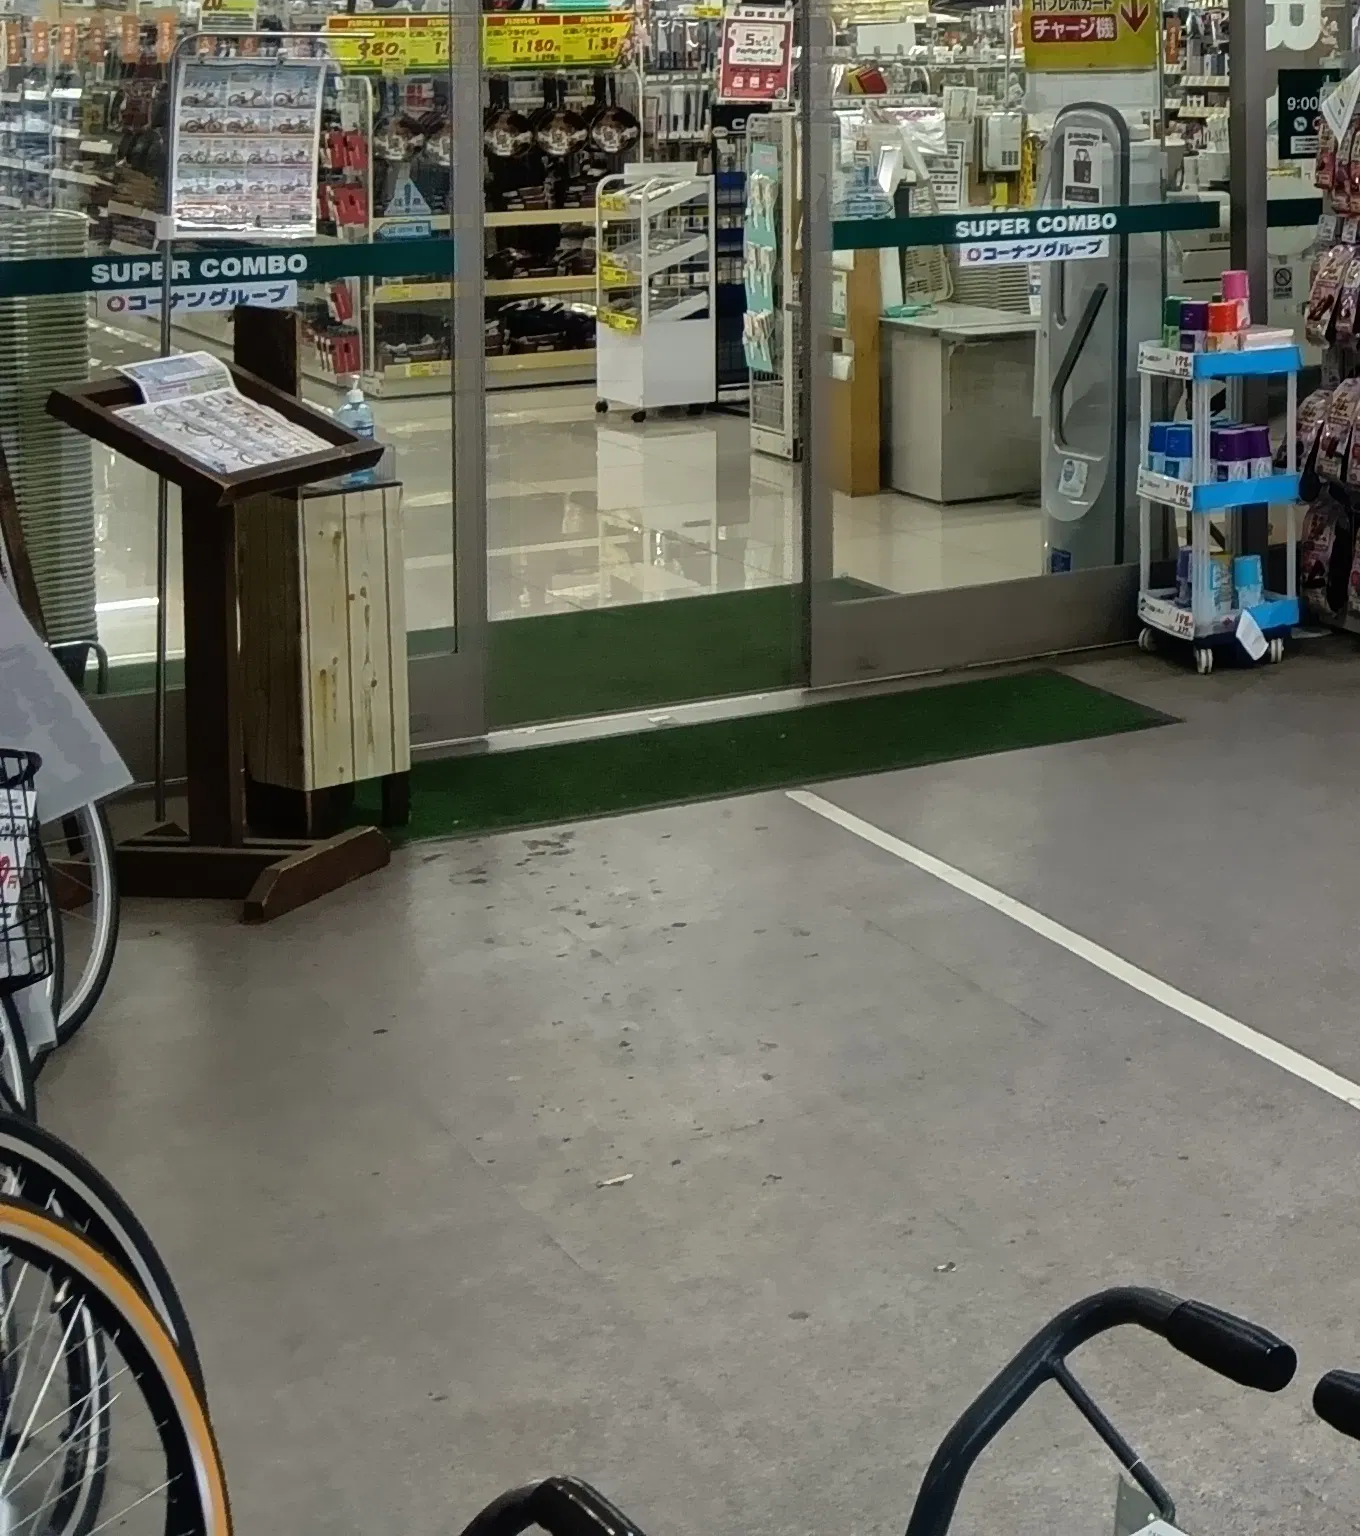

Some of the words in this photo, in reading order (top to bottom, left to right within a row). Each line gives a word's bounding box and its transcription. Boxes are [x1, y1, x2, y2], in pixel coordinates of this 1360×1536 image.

[1032, 17, 1117, 40] チャージ機
[955, 218, 1030, 238] SUPER
[1036, 212, 1118, 235] COMBO
[982, 239, 1103, 262] コーナングループ
[91, 260, 190, 285] SUPER
[200, 253, 308, 279] COMBO
